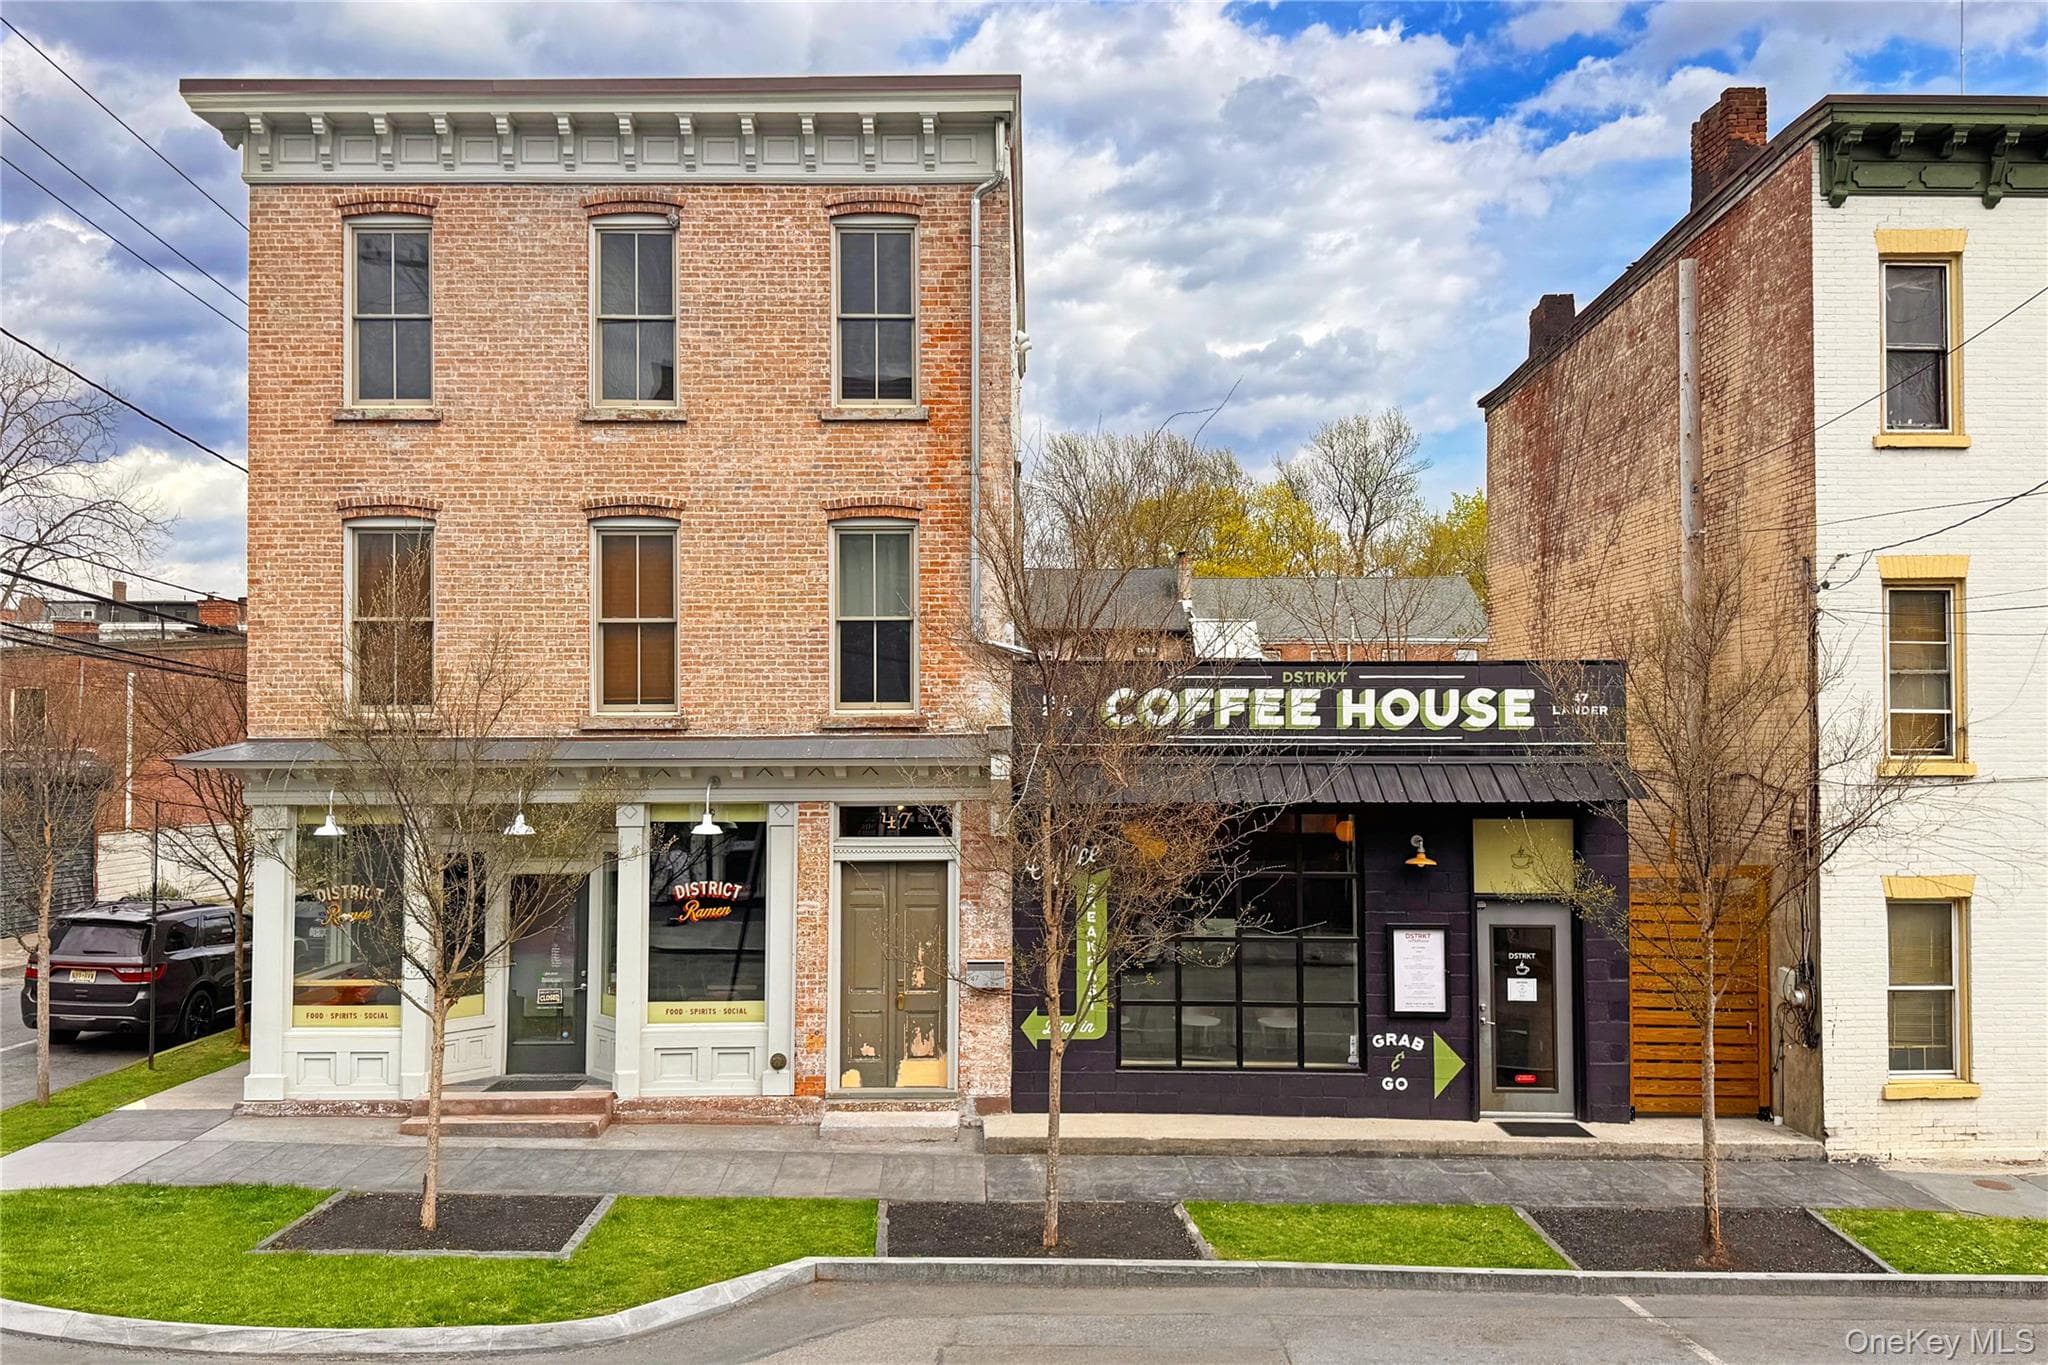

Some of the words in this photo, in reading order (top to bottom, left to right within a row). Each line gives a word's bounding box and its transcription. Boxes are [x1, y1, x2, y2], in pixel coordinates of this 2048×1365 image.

[1282, 671, 1348, 683] DSTRKT
[1101, 688, 1321, 729] COFFEE
[1336, 688, 1535, 731] HOUSE
[1552, 705, 1609, 715] LANDER
[881, 811, 913, 830] 47
[314, 884, 385, 902] DISTRICT
[673, 881, 743, 901] DISTRICT
[321, 903, 374, 926] Rmen
[679, 900, 732, 923] Ramen
[1508, 952, 1537, 960] DSTRKT
[330, 1012, 358, 1020] SPIRITS
[1079, 1020, 1096, 1033] in
[1372, 1033, 1425, 1051] GRAB
[1382, 1077, 1408, 1090] GO
